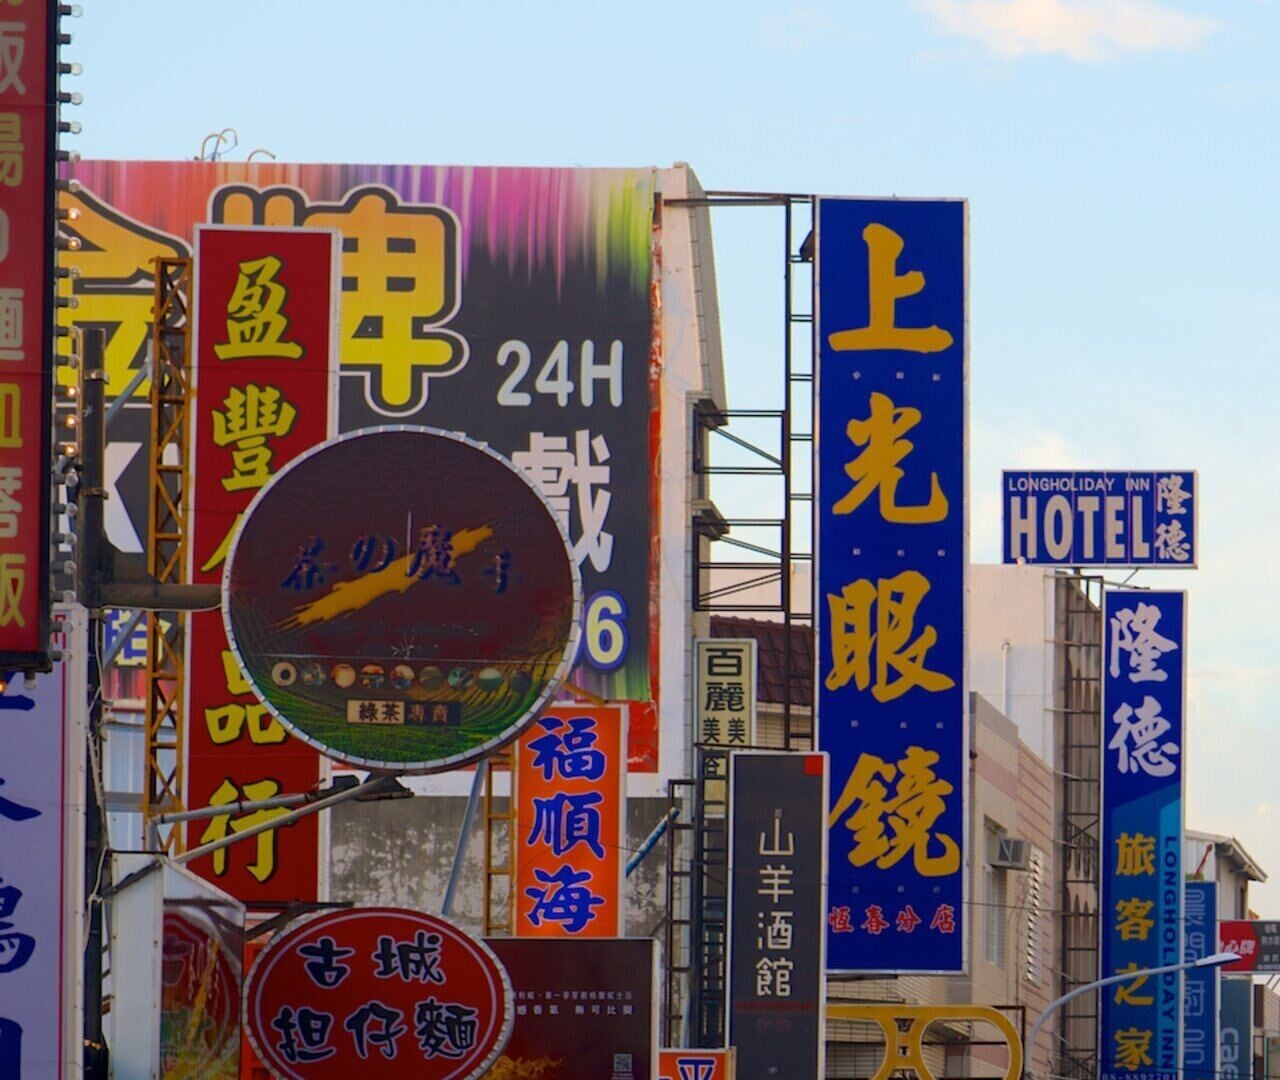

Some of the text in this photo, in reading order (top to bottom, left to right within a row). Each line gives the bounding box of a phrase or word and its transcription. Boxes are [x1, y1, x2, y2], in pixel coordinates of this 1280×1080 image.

[495, 338, 626, 408] 24H
[200, 255, 305, 884] 盈豐品行
[826, 222, 960, 878] 上光眼鏡
[1008, 478, 1150, 493] LONGHOLIDAY INN
[1010, 494, 1151, 560] HOTEL
[1154, 474, 1193, 562] 隆德
[1108, 602, 1181, 778] 隆德
[526, 713, 608, 934] 福順海
[755, 812, 795, 997] 山羊酒館
[298, 931, 448, 987] 古城
[1114, 832, 1157, 1072] 旅客之家
